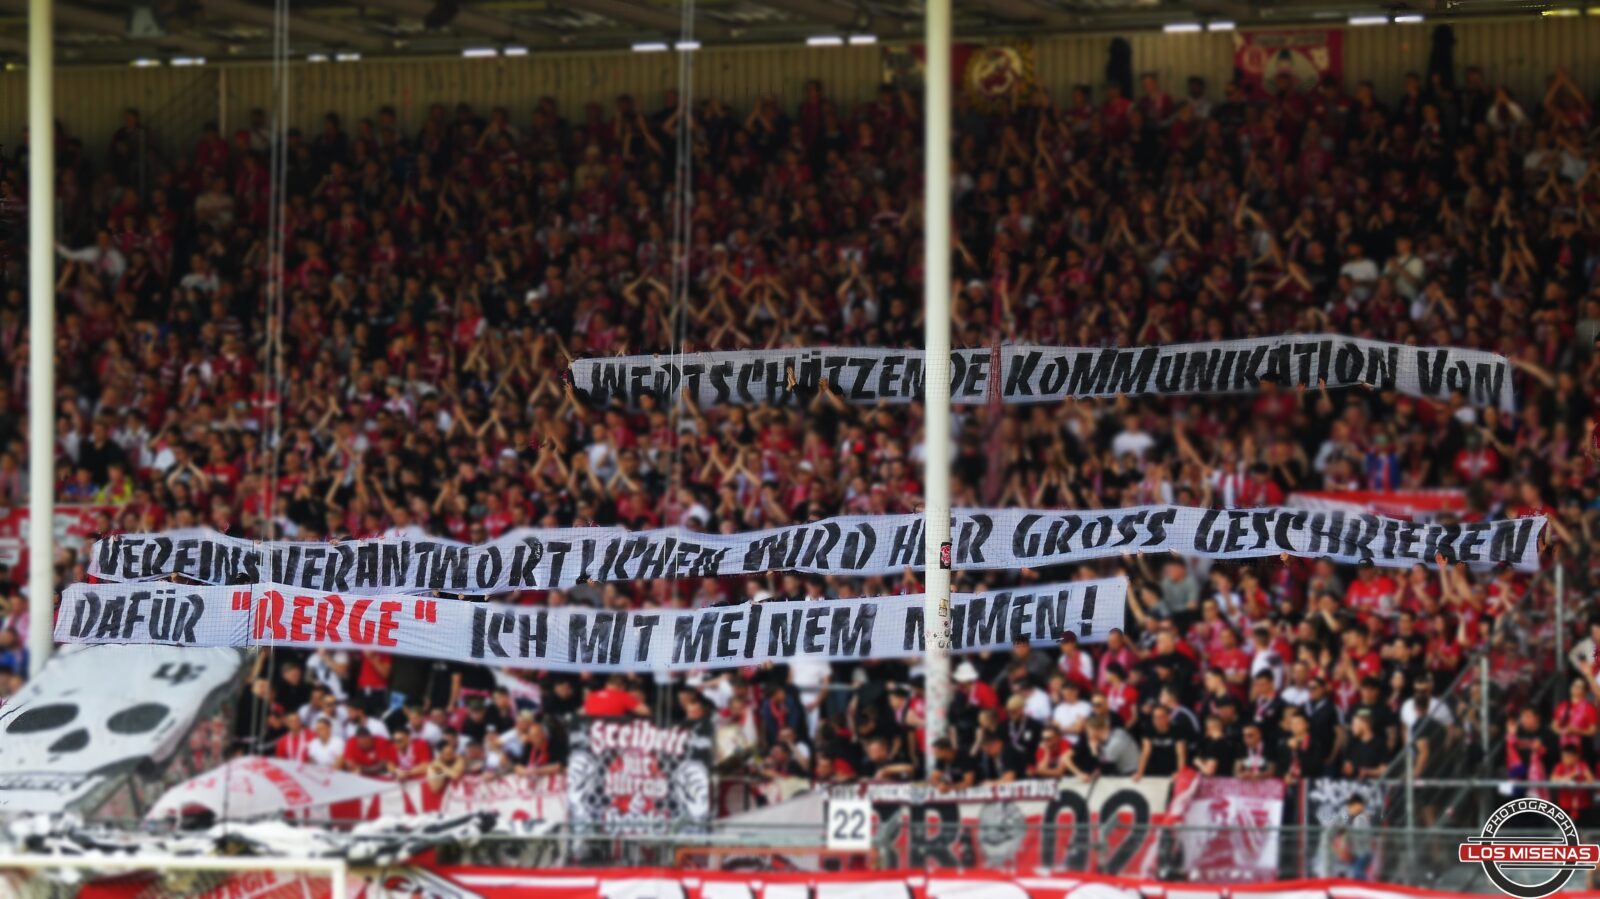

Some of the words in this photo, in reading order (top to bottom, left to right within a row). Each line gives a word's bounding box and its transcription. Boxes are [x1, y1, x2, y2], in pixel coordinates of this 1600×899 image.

[1004, 340, 1398, 396] KOMMUNIKATION
[1417, 350, 1505, 403] VON
[743, 522, 876, 571] WIRD
[888, 514, 993, 568] HIR
[1012, 508, 1177, 558] GROSS
[1194, 508, 1534, 565] GESCHRIEBEN
[70, 589, 204, 642] DAFÜR
[471, 607, 548, 658] ICH
[568, 612, 659, 664] MIT
[672, 603, 877, 664] MEINEM
[833, 808, 867, 839] 22
